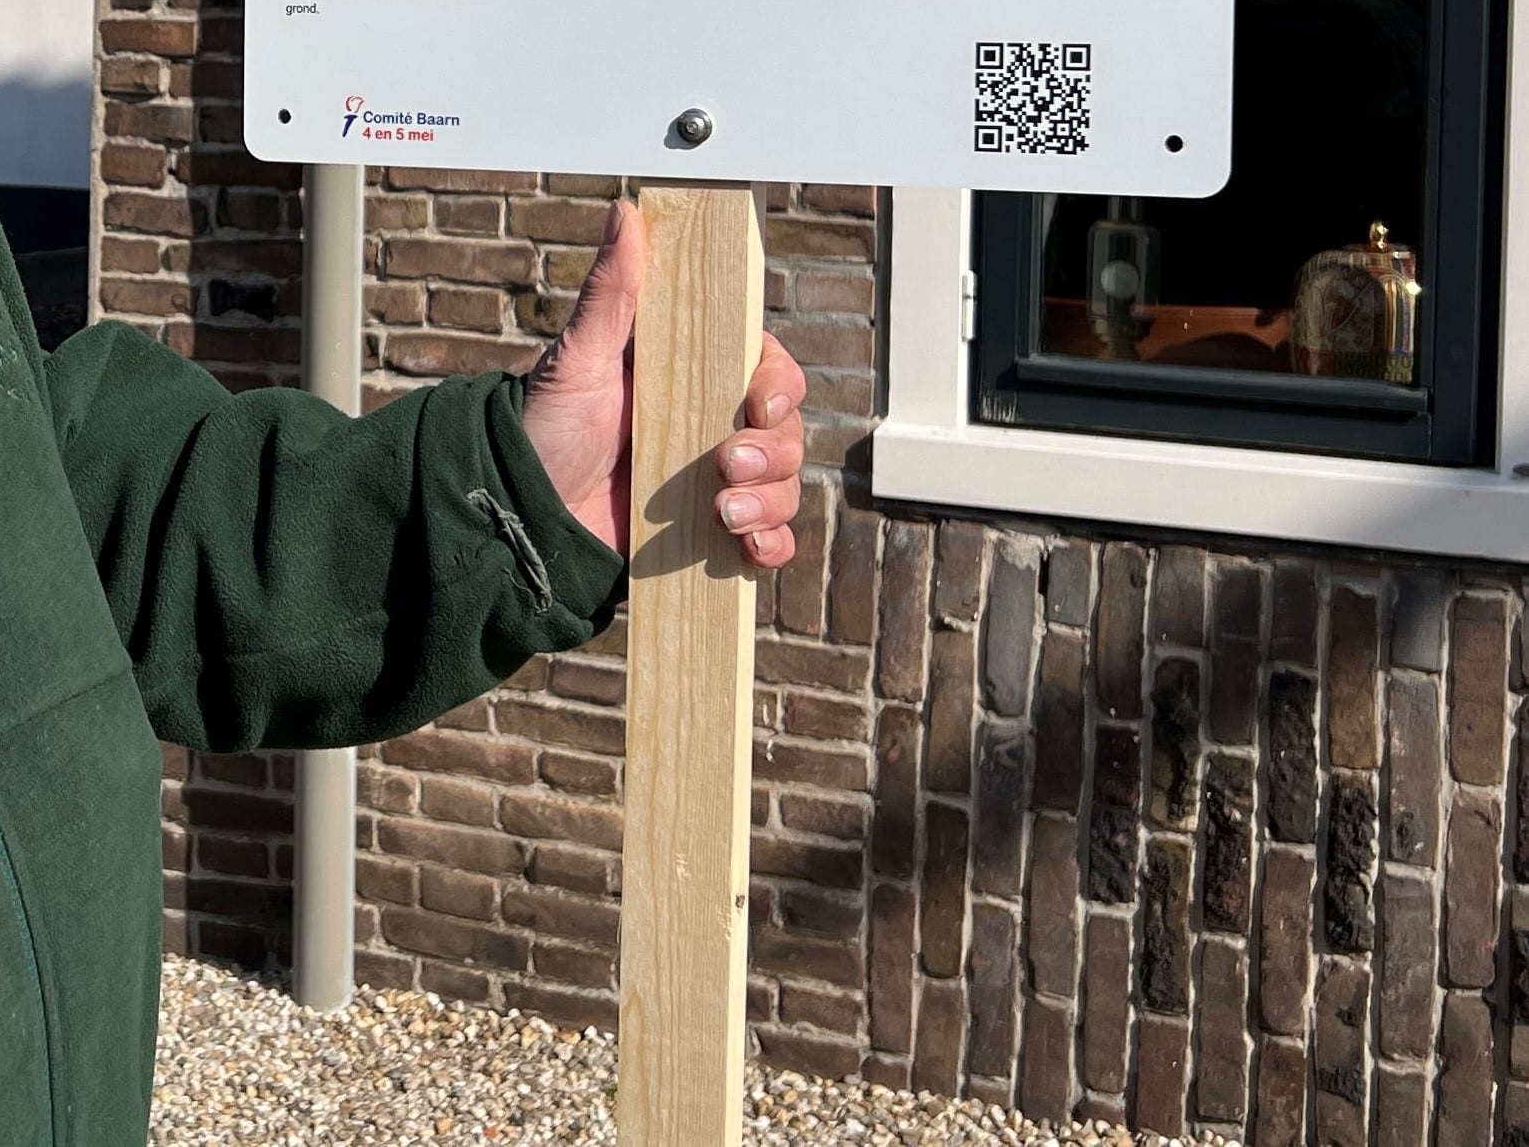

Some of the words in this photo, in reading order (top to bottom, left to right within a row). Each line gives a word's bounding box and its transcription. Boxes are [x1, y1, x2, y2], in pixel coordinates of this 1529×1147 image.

[285, 2, 319, 16] grond.
[363, 110, 412, 124] Comité
[416, 112, 460, 126] Baarn
[362, 126, 371, 139] 4
[374, 128, 392, 139] en
[395, 127, 404, 140] 5
[407, 129, 433, 141] mei
